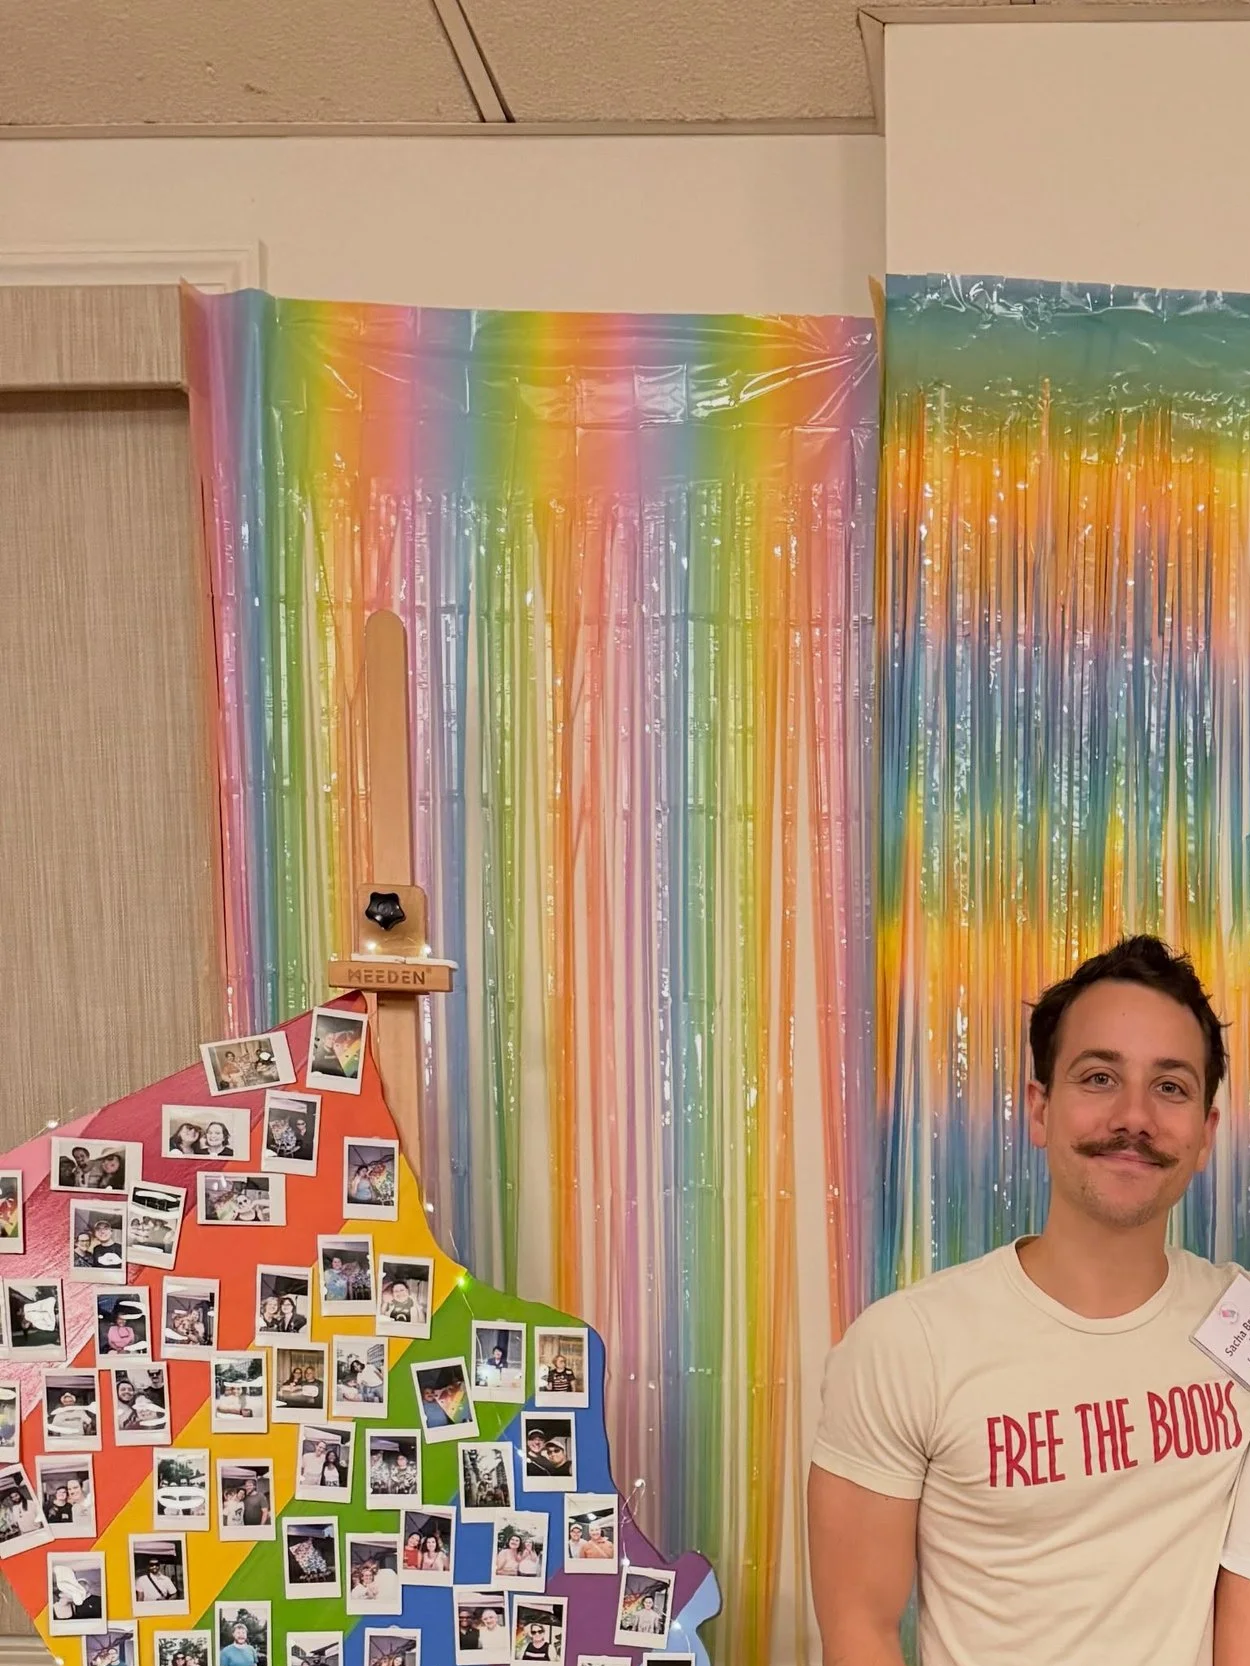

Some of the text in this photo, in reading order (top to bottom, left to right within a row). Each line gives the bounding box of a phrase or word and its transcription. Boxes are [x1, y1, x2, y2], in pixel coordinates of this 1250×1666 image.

[348, 969, 425, 985] MEEDEN
[1225, 1330, 1247, 1357] Sacha
[987, 1380, 1242, 1487] FREE THE BOOKS
